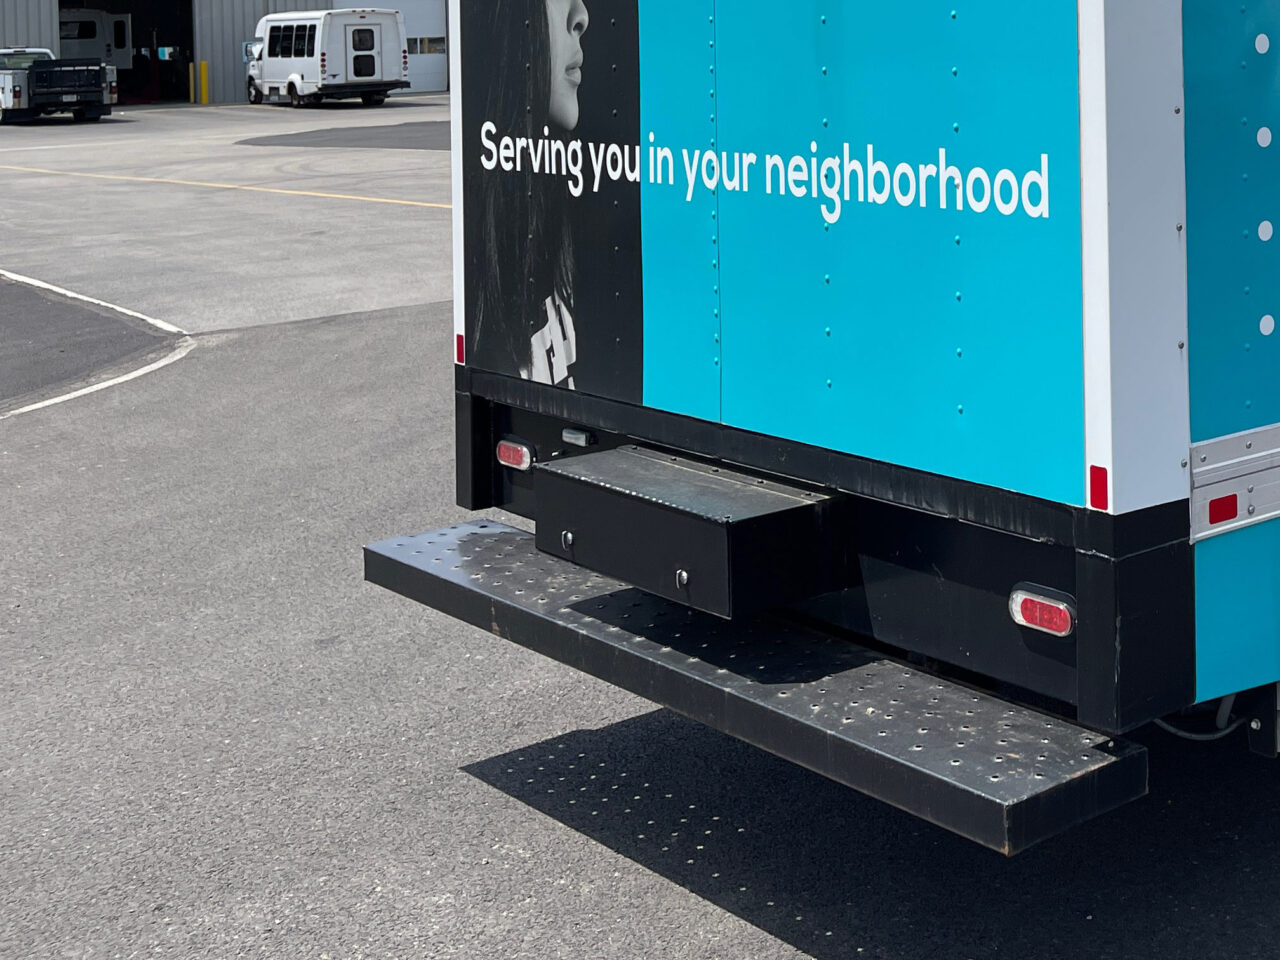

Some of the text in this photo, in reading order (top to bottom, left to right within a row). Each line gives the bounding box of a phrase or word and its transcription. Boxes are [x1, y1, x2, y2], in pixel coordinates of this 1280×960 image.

[480, 121, 1050, 224] Serving you in your neighborhood
